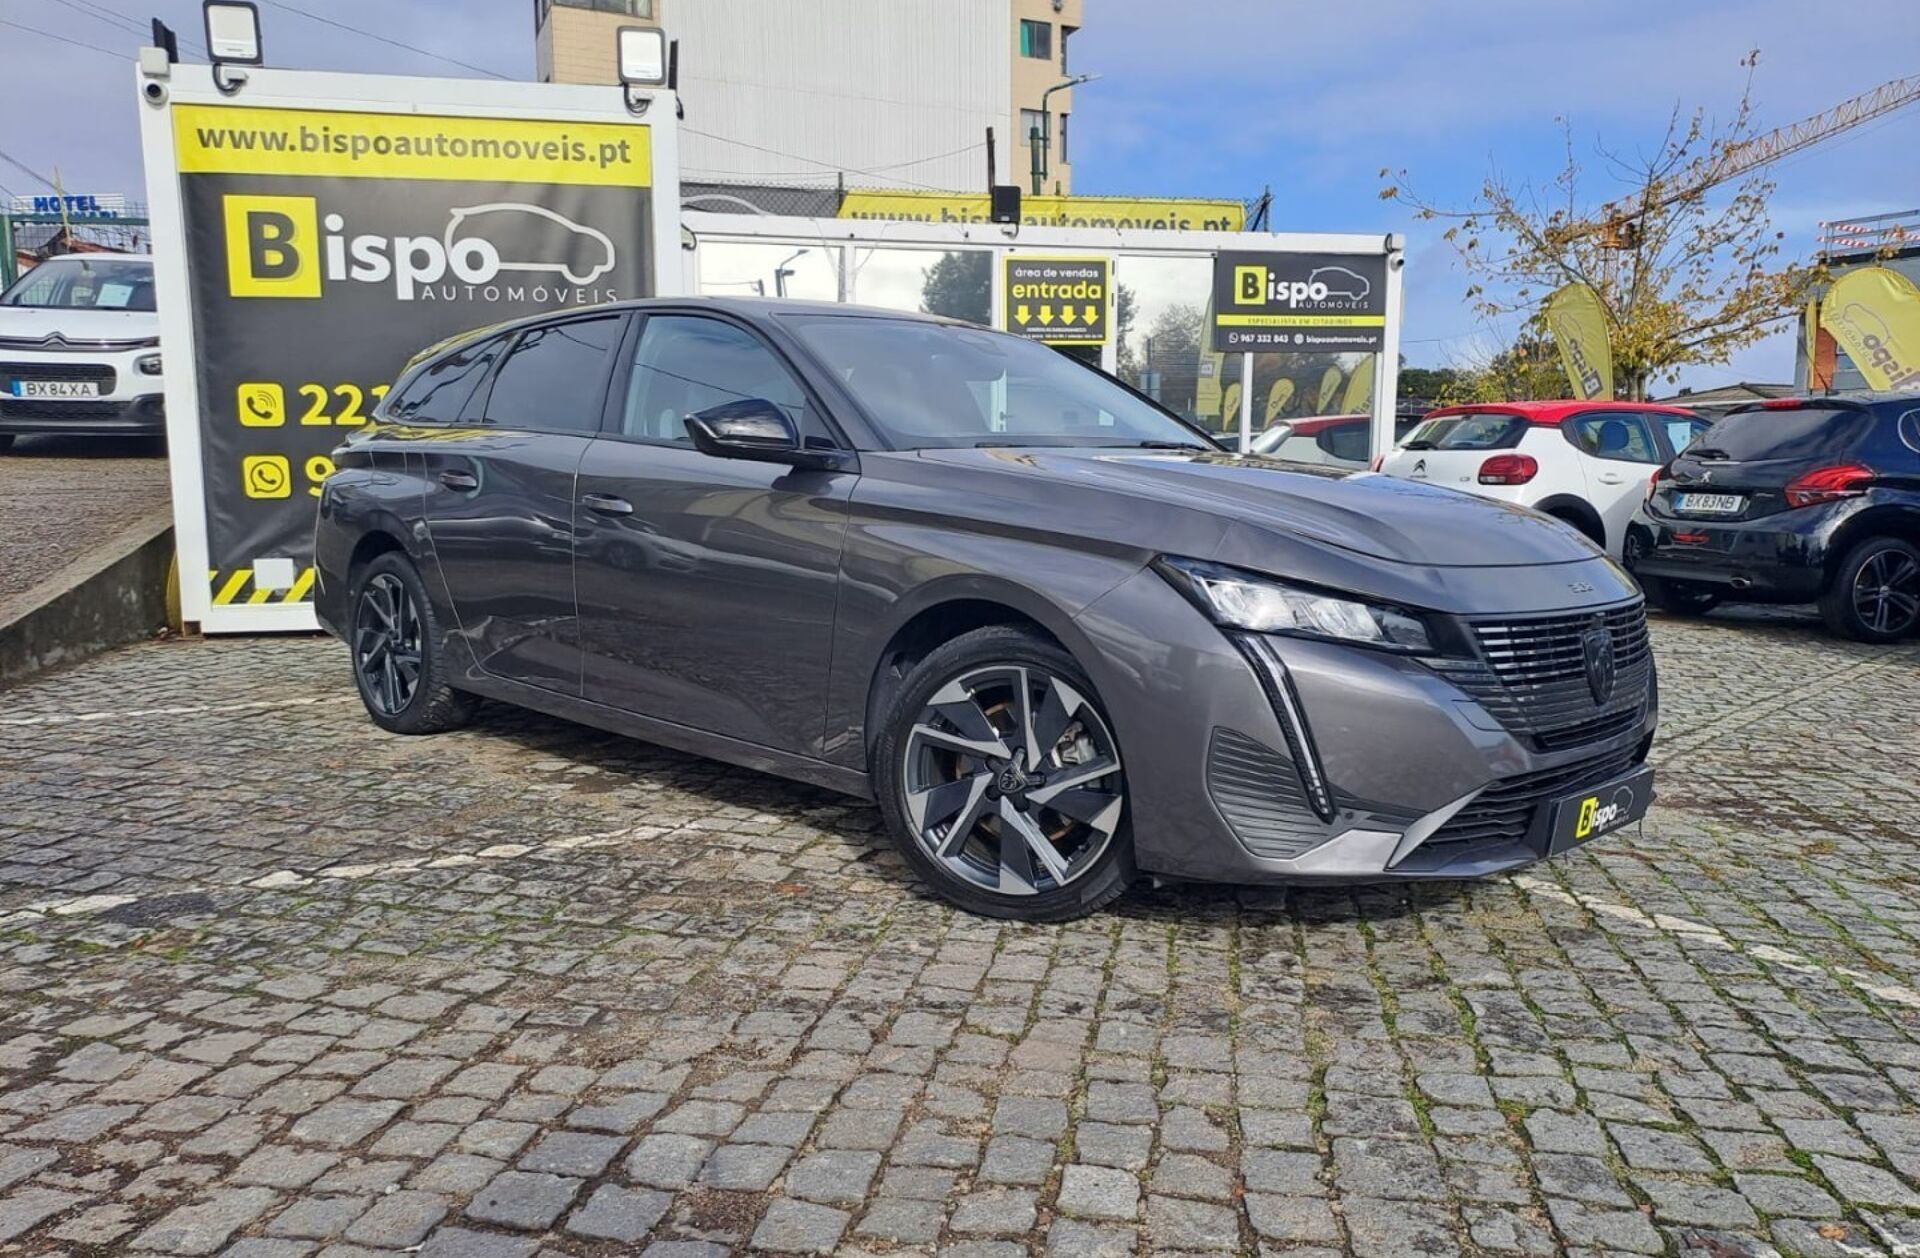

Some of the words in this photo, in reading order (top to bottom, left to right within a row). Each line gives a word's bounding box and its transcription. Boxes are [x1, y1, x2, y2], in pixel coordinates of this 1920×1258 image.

[196, 126, 631, 168] www.bispoautomoveis.pt
[33, 195, 100, 212] HOTEL
[247, 211, 500, 300] Bispo
[1015, 267, 1041, 277] área
[1043, 268, 1057, 277] de
[1060, 268, 1099, 278] vendas
[422, 284, 618, 303] AUTOMÓVEIS
[1012, 281, 1102, 299] entrada
[1241, 272, 1328, 308] Bispo
[1579, 801, 1617, 833] Bispo
